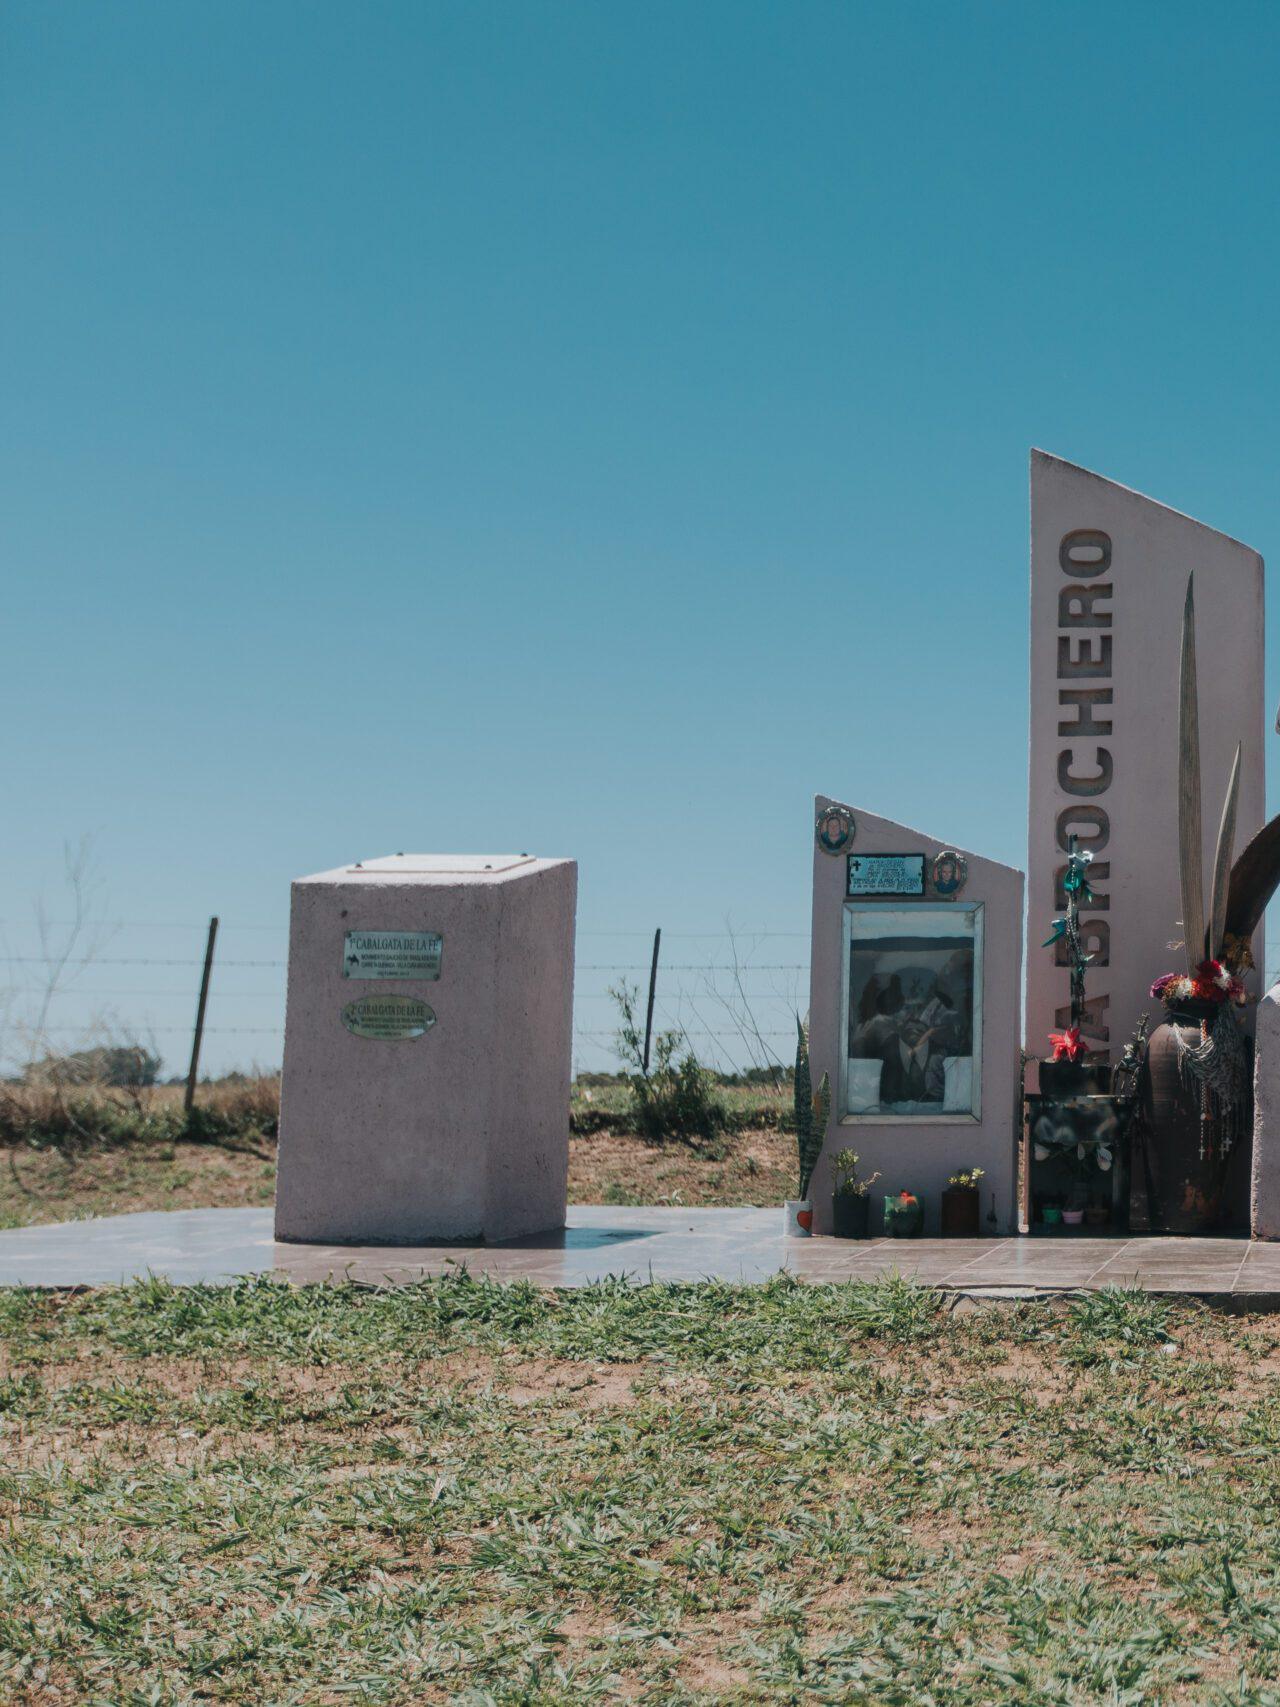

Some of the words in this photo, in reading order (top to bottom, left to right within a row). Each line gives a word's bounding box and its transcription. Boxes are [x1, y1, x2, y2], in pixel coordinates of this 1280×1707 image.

[1055, 528, 1114, 967] BROCHERO
[356, 937, 402, 950] CABALGATA
[404, 938, 415, 951] DE
